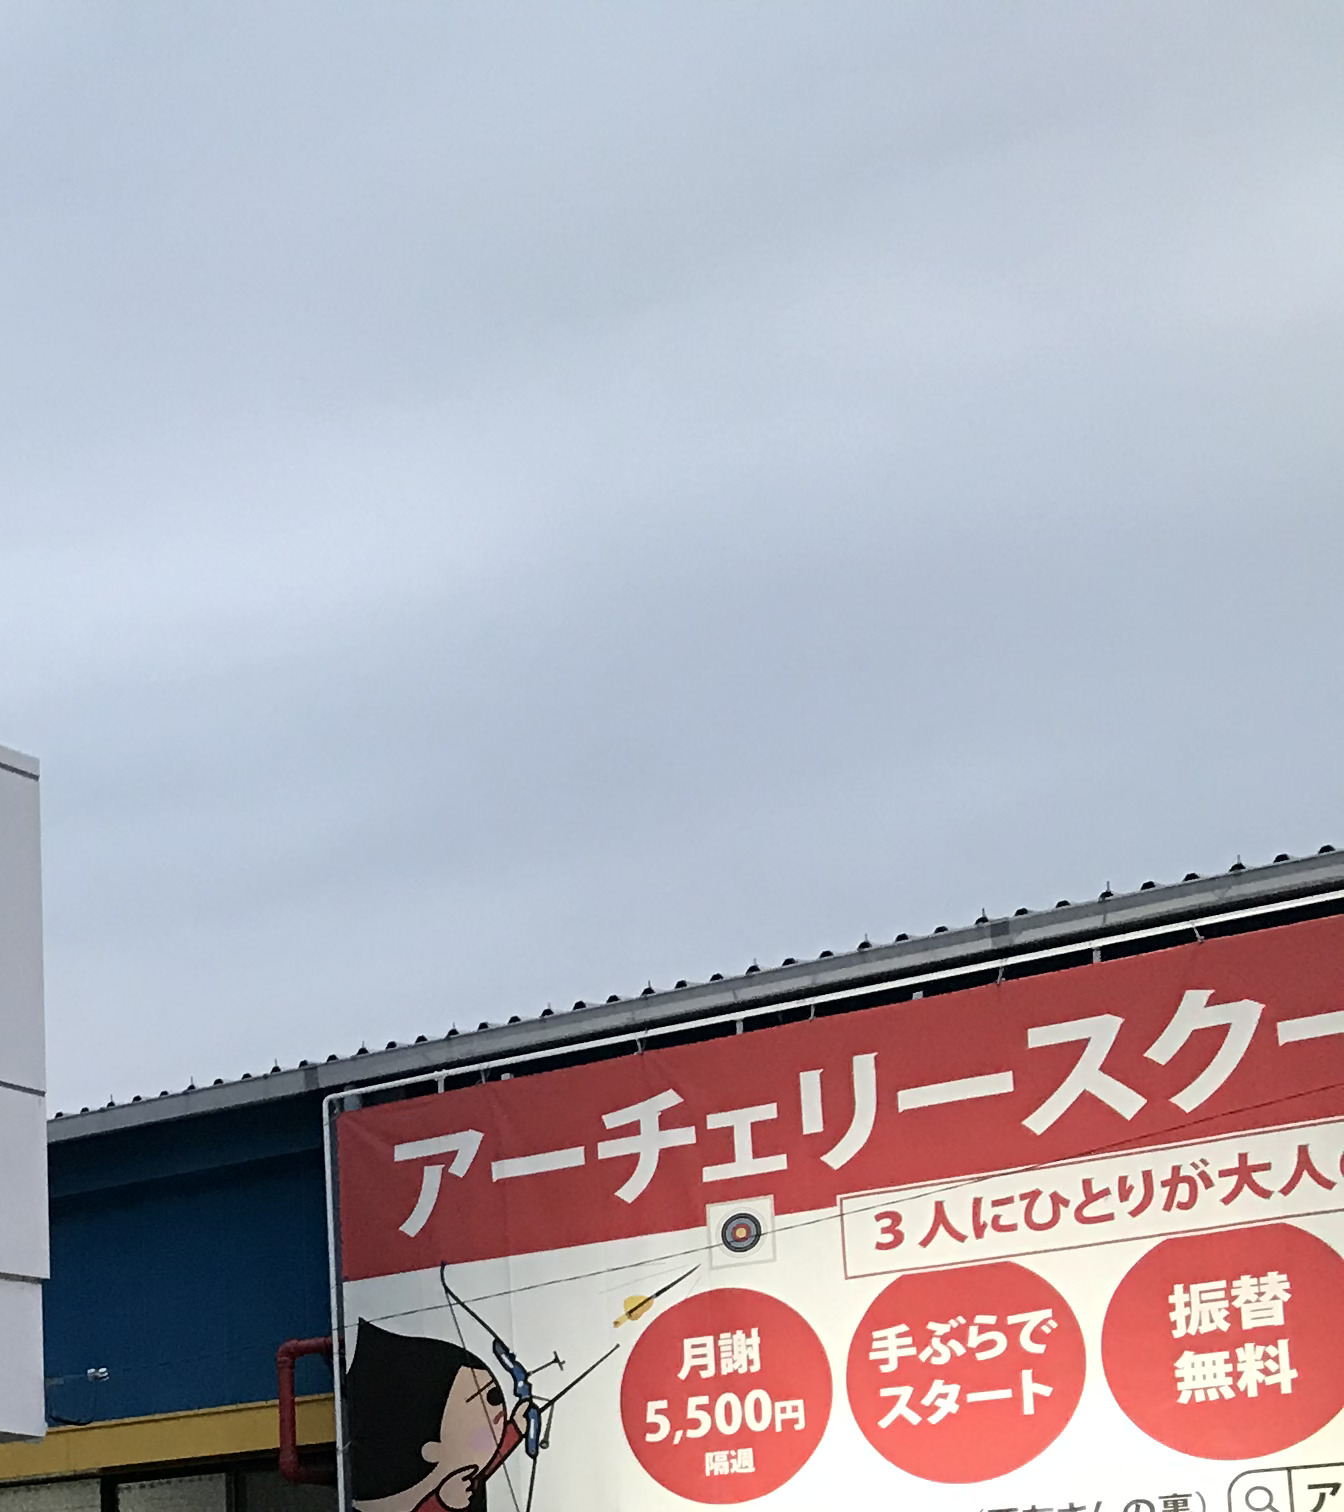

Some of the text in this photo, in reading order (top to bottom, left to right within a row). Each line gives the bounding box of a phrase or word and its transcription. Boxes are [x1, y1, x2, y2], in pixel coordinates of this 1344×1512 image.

[393, 989, 1344, 1238] アーチェリースクー
[874, 1143, 1344, 1251] 3人にひとりが大人
[1168, 1271, 1294, 1339] 振替
[677, 1328, 762, 1381] 月謝
[869, 1309, 1059, 1374] 手ぶらで
[1174, 1338, 1299, 1406] 無料
[645, 1389, 806, 1445] 5,500円
[877, 1369, 1054, 1430] スタート
[704, 1447, 756, 1477] 隔週
